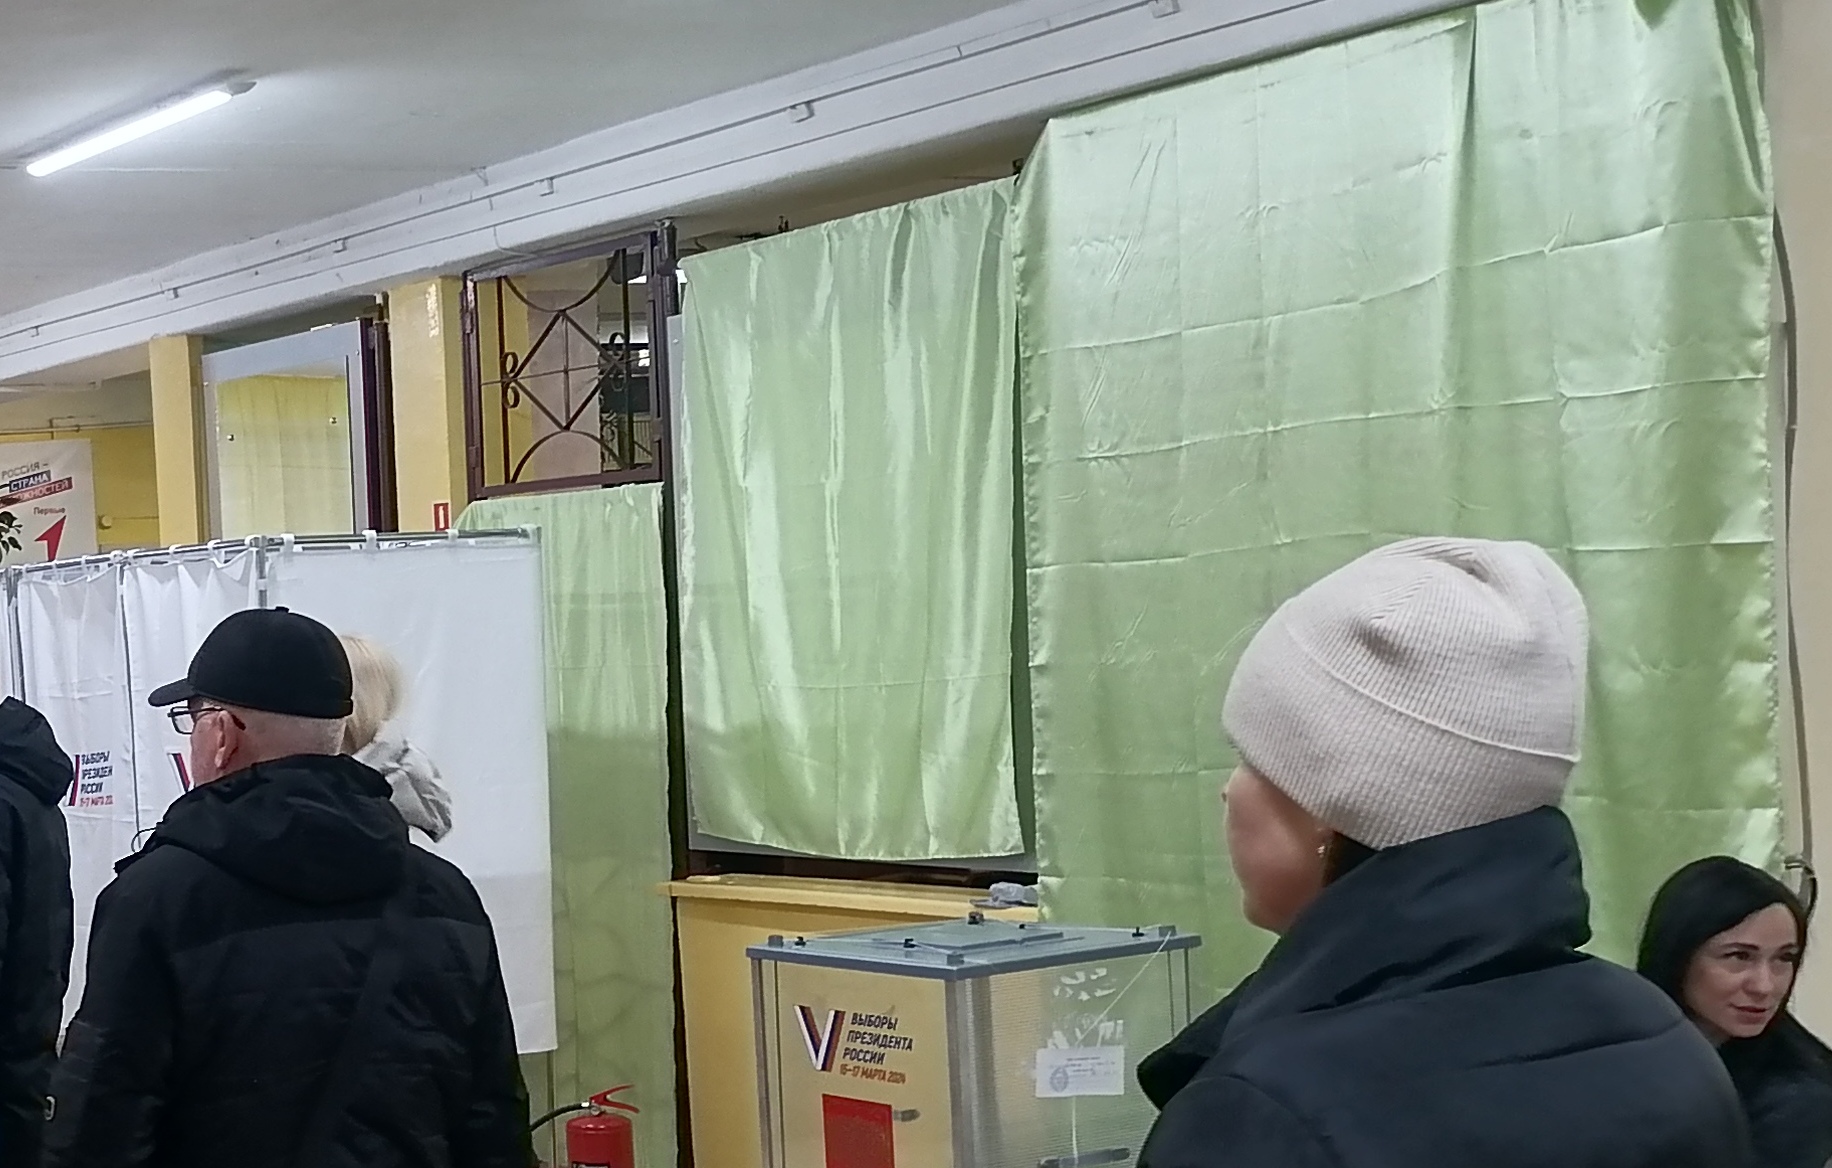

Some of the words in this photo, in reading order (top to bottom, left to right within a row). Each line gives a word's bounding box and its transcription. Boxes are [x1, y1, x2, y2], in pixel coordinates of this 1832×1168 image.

[1, 461, 40, 479] РОССИЯ
[10, 472, 49, 492] СТРАНА
[850, 1012, 898, 1031] ВЫБОРЫ
[846, 1030, 913, 1051] ПРЕЗИДЕНТА
[842, 1047, 885, 1065] РОССИИ
[860, 1067, 886, 1082] МАРТА
[887, 1071, 906, 1084] 2024
